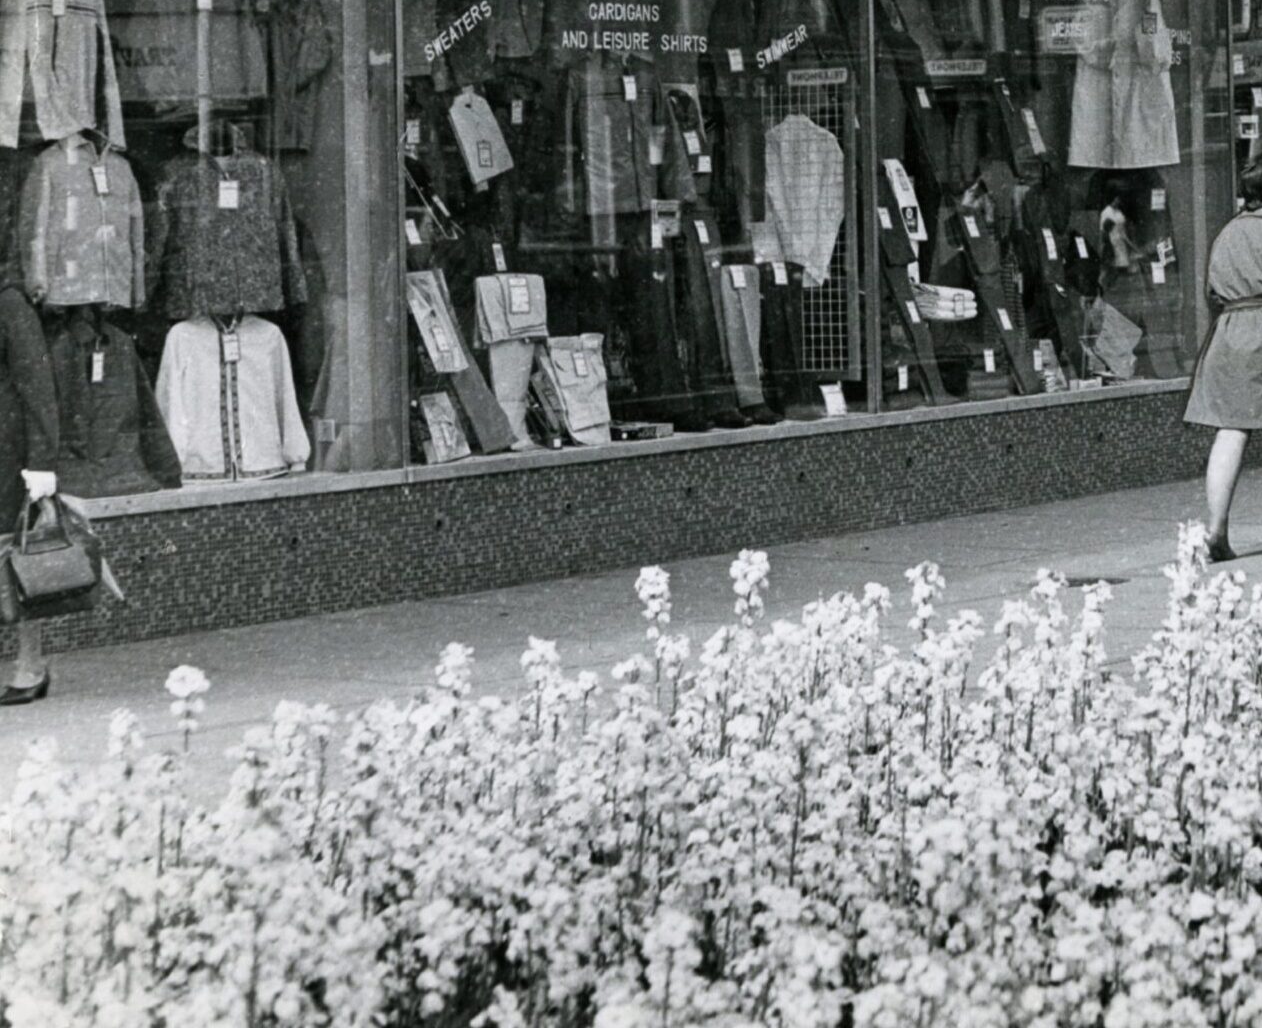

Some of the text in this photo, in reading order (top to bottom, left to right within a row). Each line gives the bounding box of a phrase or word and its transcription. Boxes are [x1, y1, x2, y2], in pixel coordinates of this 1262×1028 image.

[589, 2, 660, 22] CARDIGANS
[424, 0, 492, 62] SWEATERS
[562, 30, 708, 53] AND LEISURE SHIRTS
